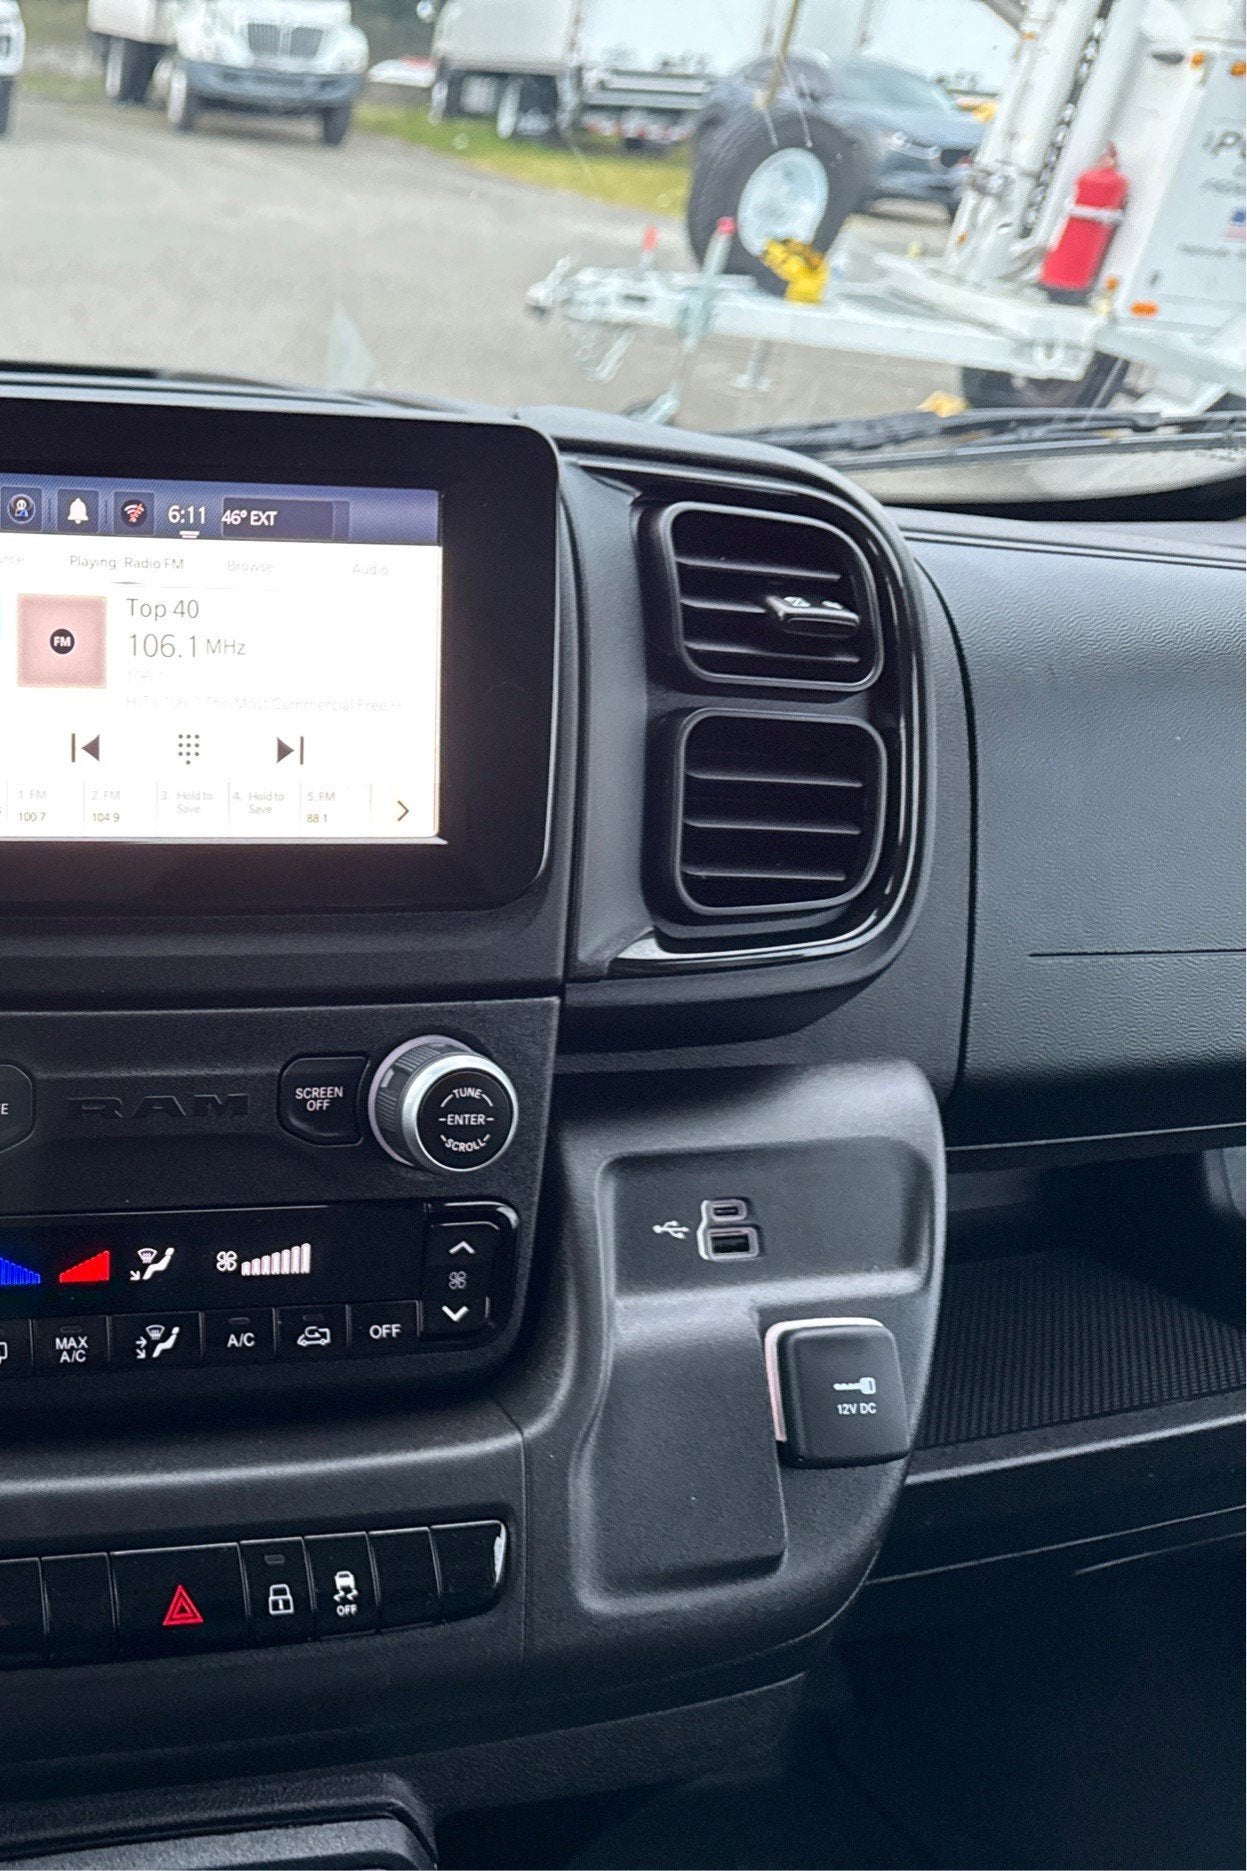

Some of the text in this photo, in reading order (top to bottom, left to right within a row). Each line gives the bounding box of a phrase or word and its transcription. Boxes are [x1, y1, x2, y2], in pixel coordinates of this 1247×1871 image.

[168, 505, 206, 524] 6:11
[221, 510, 277, 526] 46° EXT
[124, 557, 161, 569] Radio
[164, 558, 184, 569] FM
[227, 561, 273, 573] Browse
[352, 563, 389, 576] Audio
[126, 598, 199, 621] Top 40
[54, 636, 72, 647] FM
[129, 633, 246, 658] 106.1 MHz
[29, 790, 47, 799] FM
[103, 791, 120, 800] FM
[177, 791, 200, 800] Hold
[203, 792, 213, 800] to
[248, 792, 272, 801] Hold
[274, 793, 285, 801] to
[319, 793, 336, 802] FM
[248, 804, 272, 814] Save
[294, 1086, 344, 1100] SCREEN
[453, 1087, 483, 1099] TUNE
[67, 1092, 249, 1119] RAM
[306, 1098, 332, 1112] OFF
[445, 1139, 486, 1152] SCROLL
[369, 1324, 401, 1339] OFF
[55, 1336, 88, 1350] MAX
[227, 1332, 255, 1348] A/C
[59, 1349, 87, 1363] A/C
[837, 1402, 876, 1415] 12V DC
[336, 1604, 357, 1616] OFF
